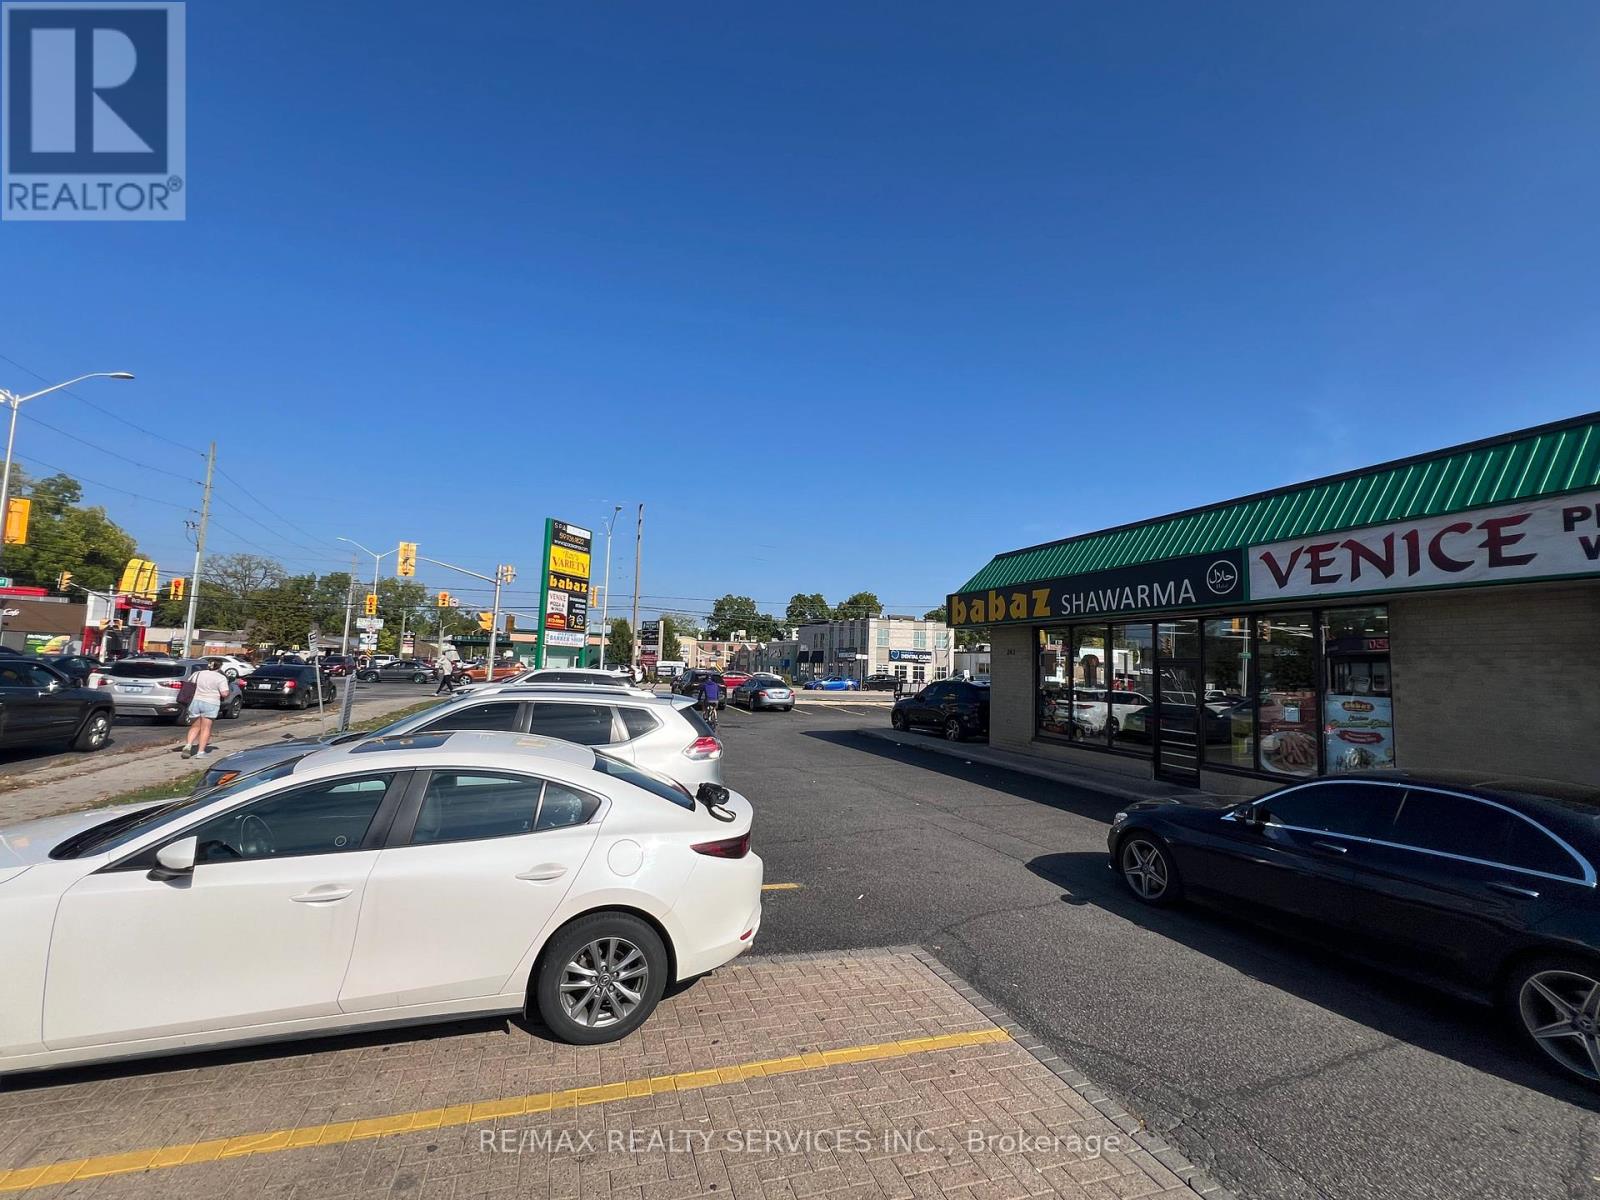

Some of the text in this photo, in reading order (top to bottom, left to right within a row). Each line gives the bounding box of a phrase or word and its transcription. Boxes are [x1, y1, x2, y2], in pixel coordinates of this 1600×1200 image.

[552, 555, 588, 573] VARIETY
[1259, 513, 1538, 589] VENICE
[549, 575, 588, 593] babaz
[950, 579, 1196, 625] babaz SHAWARMA
